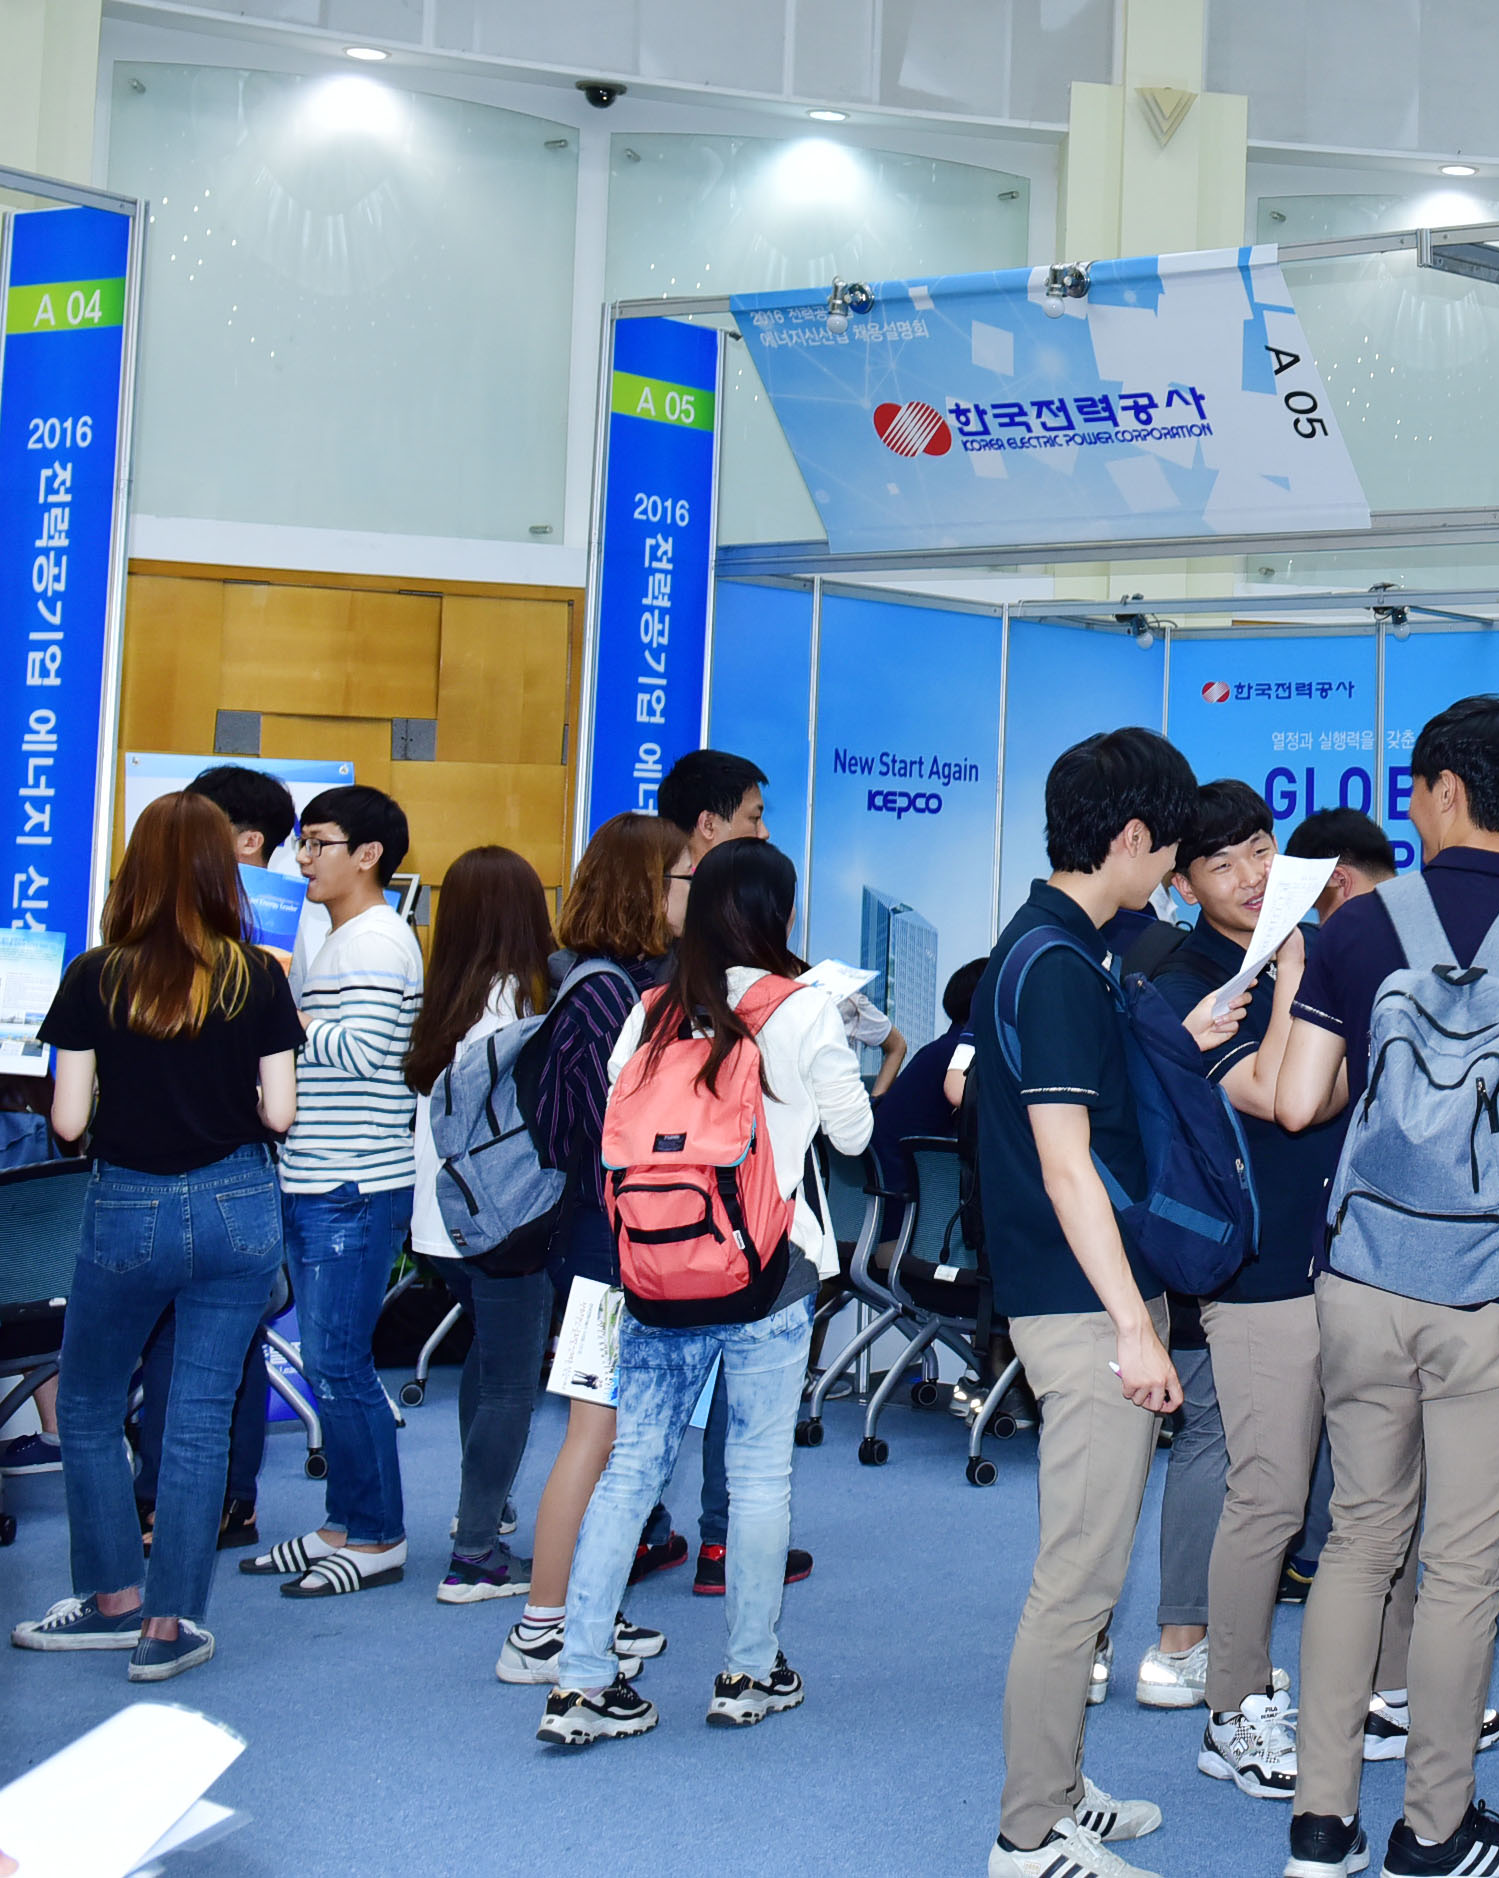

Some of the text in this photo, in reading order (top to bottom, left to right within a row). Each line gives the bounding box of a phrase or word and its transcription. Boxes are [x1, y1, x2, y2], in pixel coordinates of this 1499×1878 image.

[33, 289, 102, 328] A 04
[751, 310, 785, 326] 2016
[853, 319, 930, 343] 채용설명회
[636, 386, 695, 424] A 05
[1265, 344, 1329, 440] A 05
[948, 386, 1207, 437] 한국전력공사
[27, 415, 93, 450] 2016
[961, 421, 1214, 453] KOREA ELECTRIC POWER CORPORATION
[633, 492, 690, 527] 2016
[26, 460, 74, 687] 전력공기업
[636, 533, 674, 724] 전력공기업
[1234, 681, 1355, 700] 한국전력공사
[1272, 729, 1415, 751] 열정과 실행력을 갖춘
[15, 708, 58, 846] 에너지
[833, 747, 979, 787] New Start Again
[867, 789, 943, 820] KEPCO
